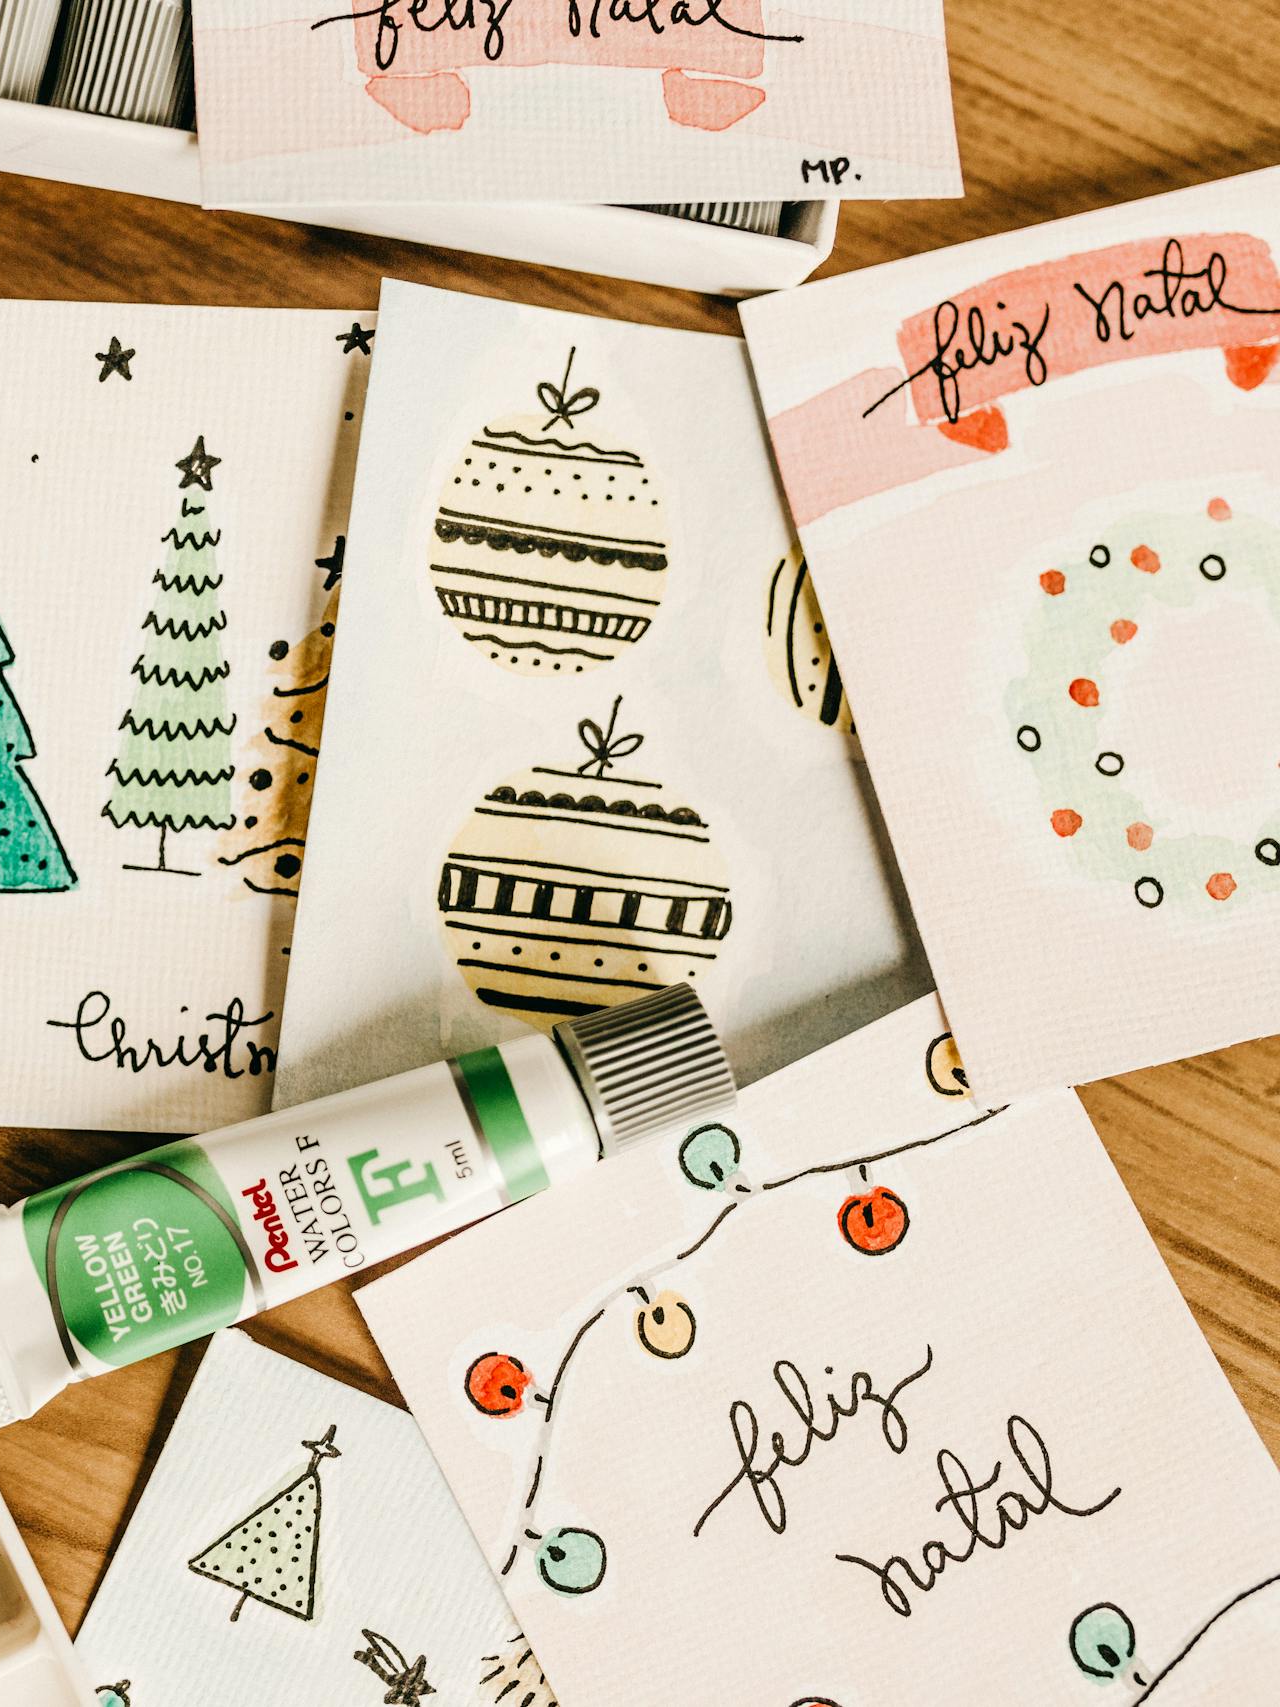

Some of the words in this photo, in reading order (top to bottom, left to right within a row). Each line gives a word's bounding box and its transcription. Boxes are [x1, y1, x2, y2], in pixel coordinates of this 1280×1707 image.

[800, 156, 863, 186] MP.
[862, 300, 1051, 424] feliz
[295, 1134, 321, 1155] F
[444, 1139, 474, 1180] 5ml
[241, 1177, 299, 1273] Pentel
[278, 1163, 330, 1265] WATER
[304, 1157, 366, 1268] COLORS
[74, 1233, 132, 1343] YELLOW
[103, 1230, 153, 1324] GREEN
[131, 1217, 188, 1317] きみどり
[692, 1343, 934, 1539] feliz
